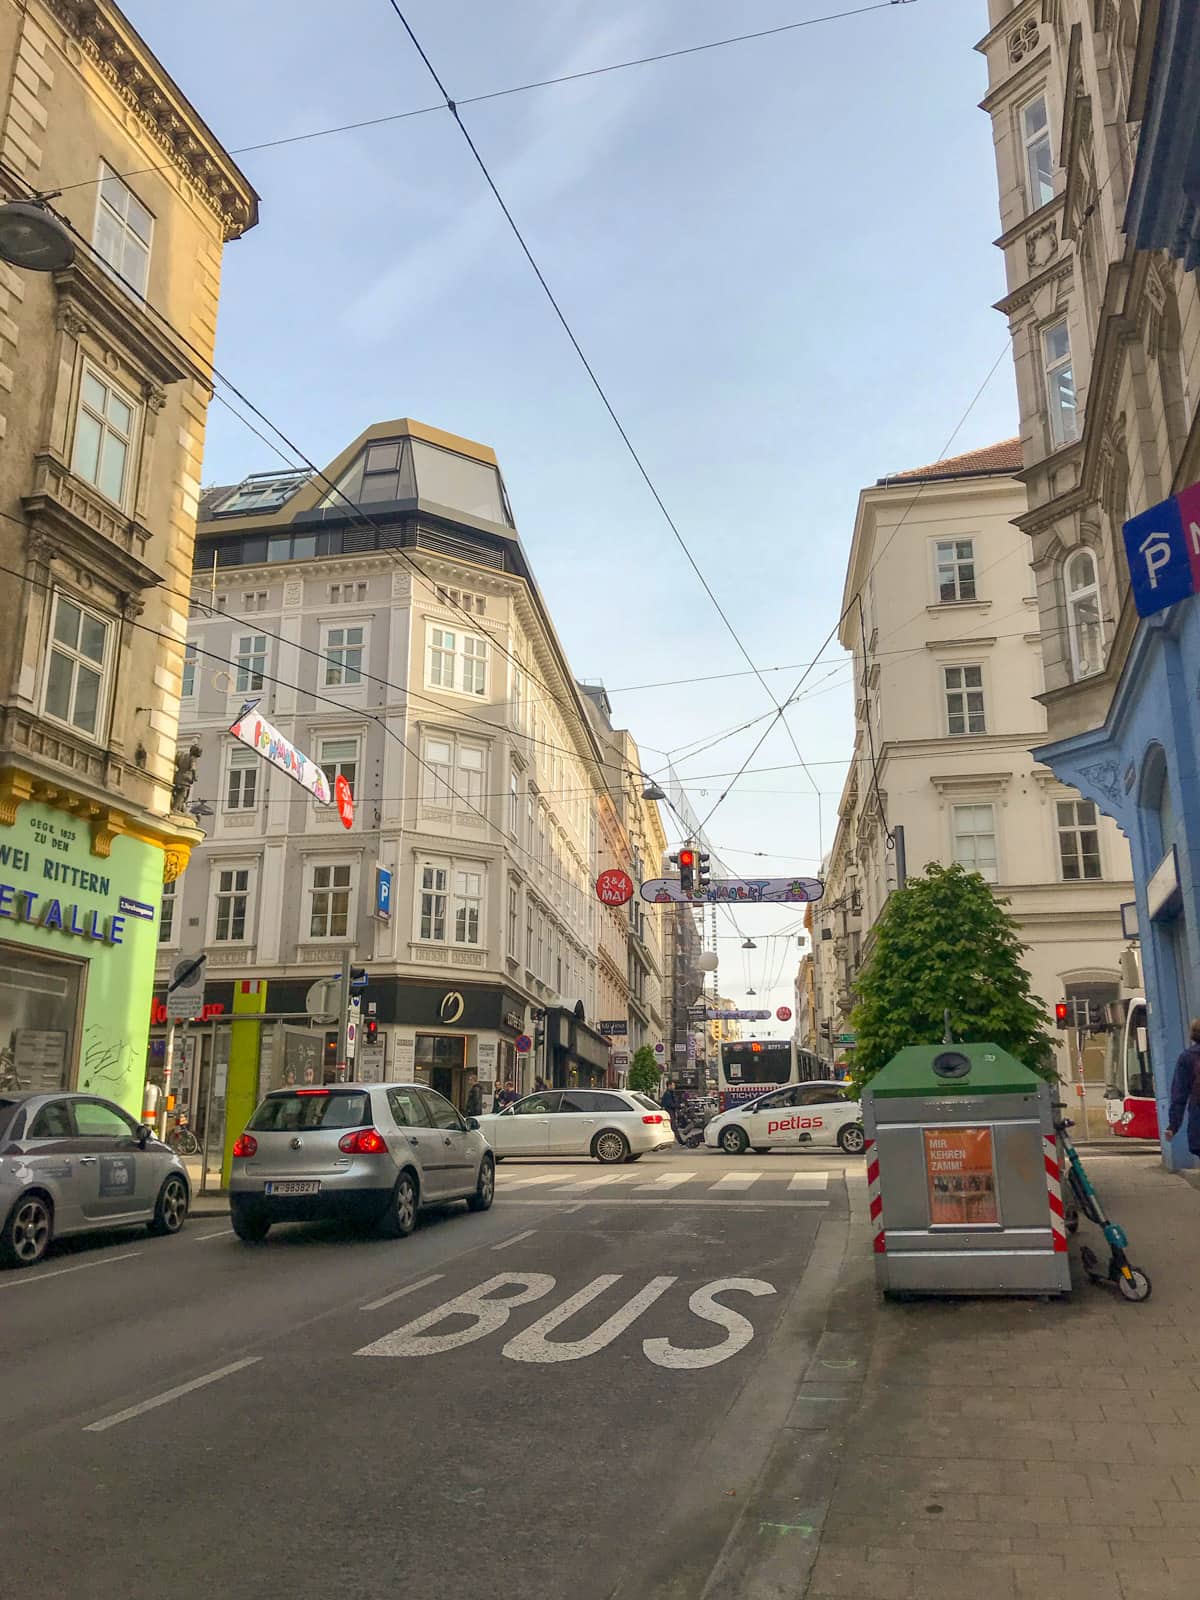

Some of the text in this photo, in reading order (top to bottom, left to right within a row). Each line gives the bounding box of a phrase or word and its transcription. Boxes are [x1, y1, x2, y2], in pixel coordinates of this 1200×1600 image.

[34, 832, 69, 852] ZU DEN
[43, 858, 110, 896] RITTERN
[601, 889, 626, 901] MAI
[768, 1116, 823, 1135] petlas
[929, 1139, 947, 1148] MIR
[930, 1150, 966, 1160] KEHREN
[931, 1160, 962, 1170] ZAMM!
[352, 1272, 777, 1369] BUS
